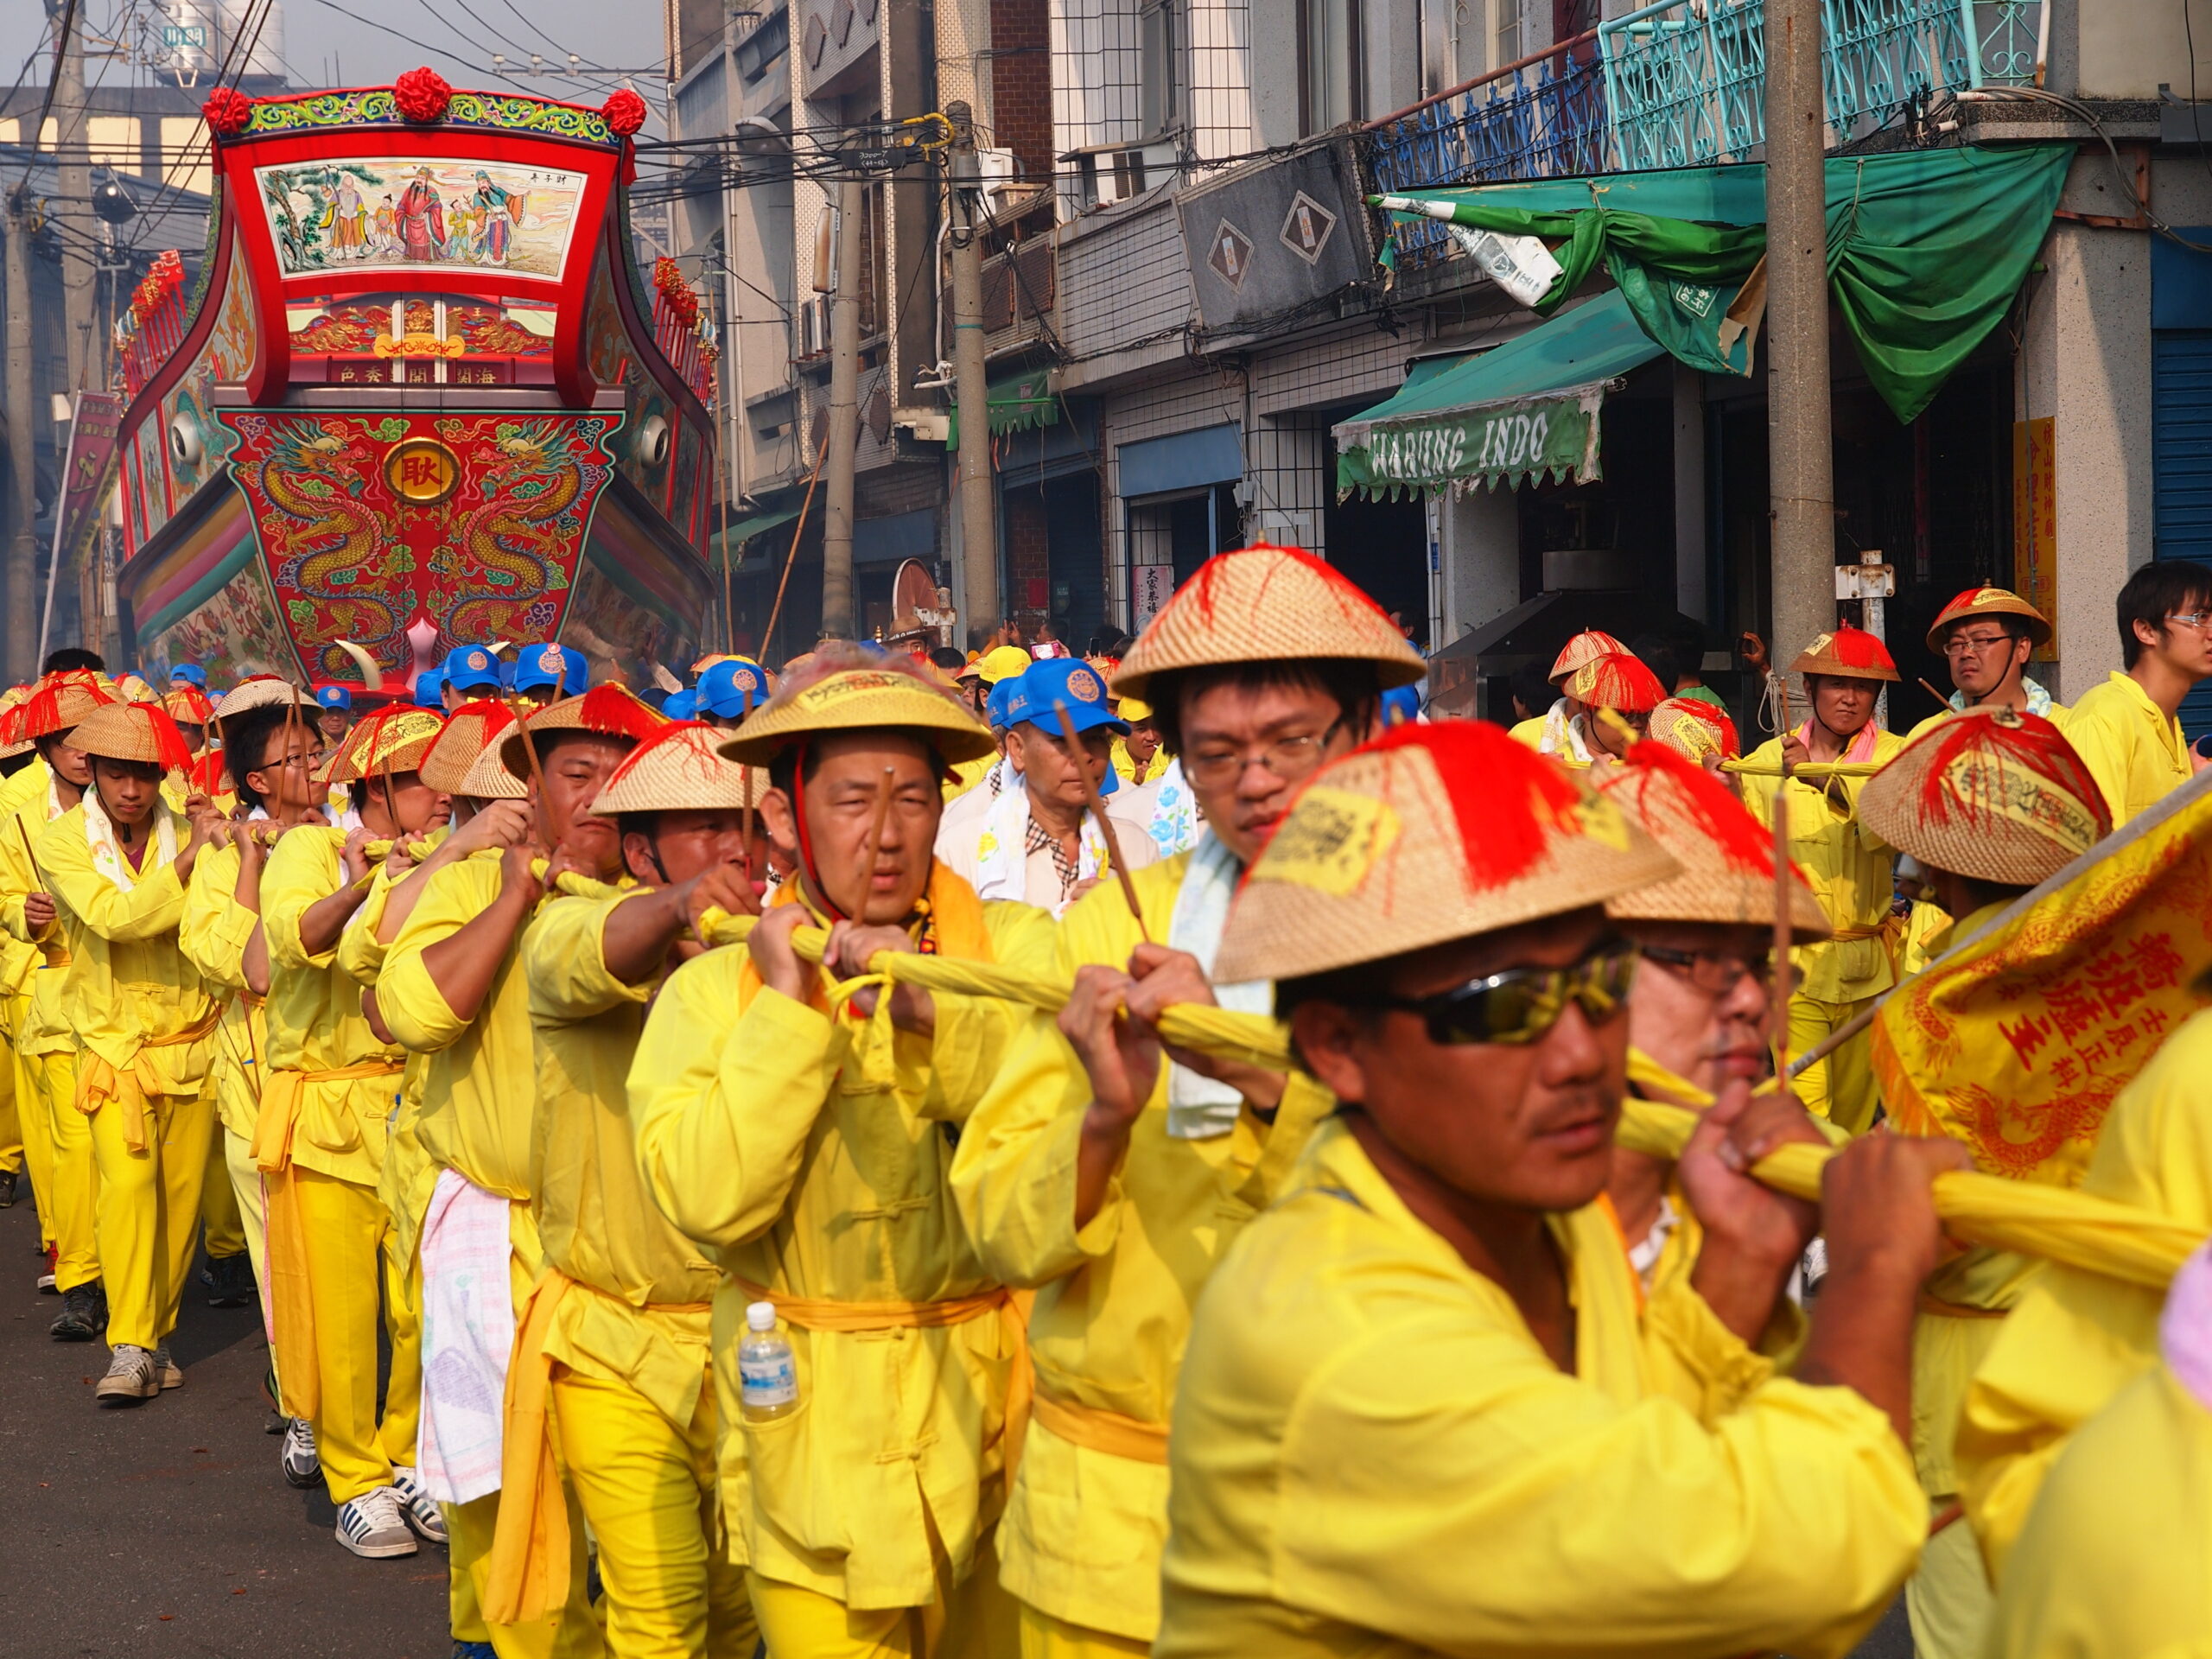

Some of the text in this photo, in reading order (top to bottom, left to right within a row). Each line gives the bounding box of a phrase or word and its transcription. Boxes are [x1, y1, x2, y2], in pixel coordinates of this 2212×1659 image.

[1681, 285, 1694, 302] 26
[1690, 287, 1711, 309] 布行
[1372, 412, 1548, 478] WARUNG INDO
[402, 456, 442, 486] 耿
[2049, 1007, 2168, 1089] 壬辰正科
